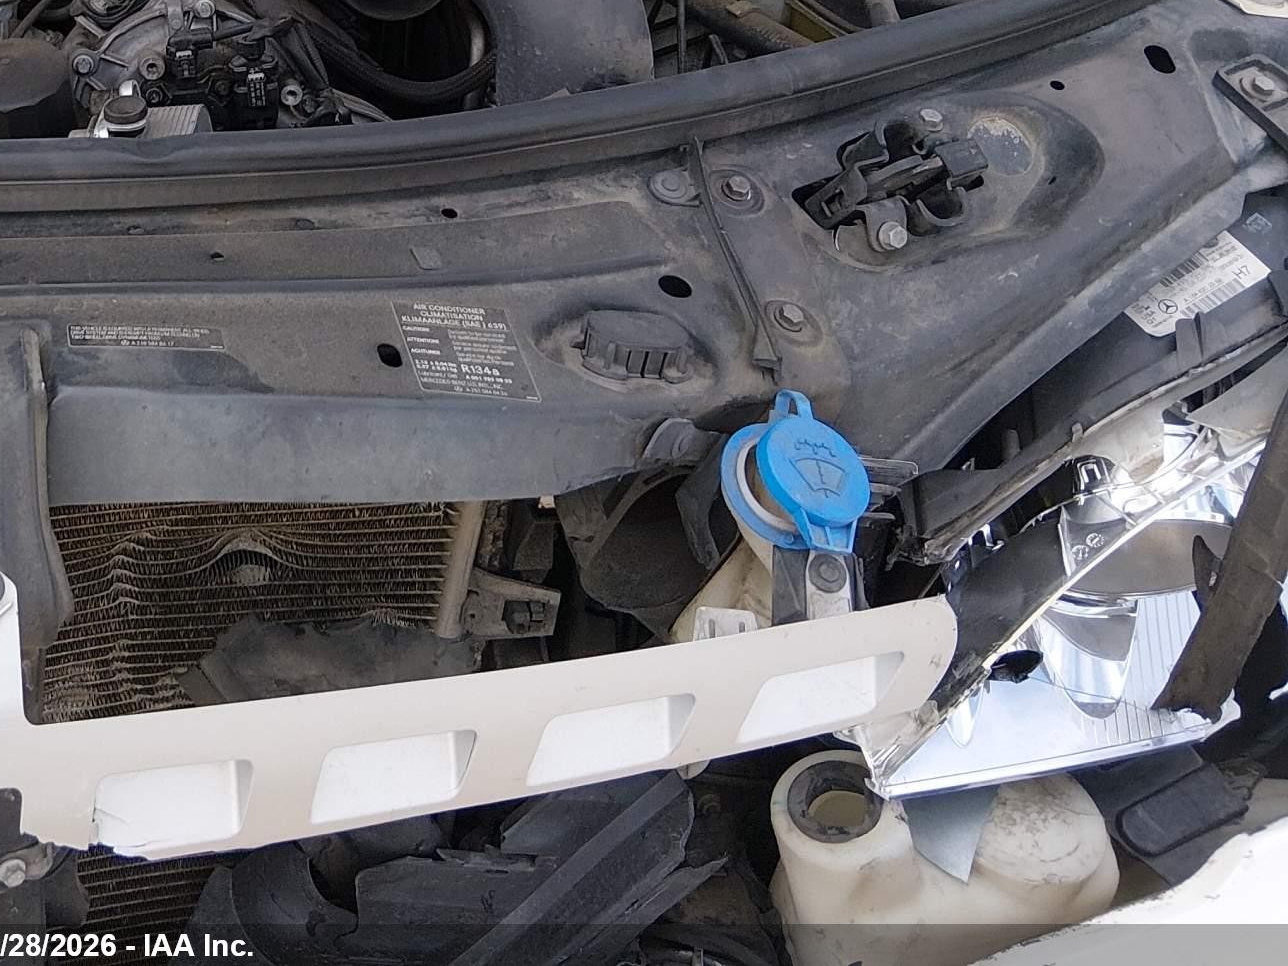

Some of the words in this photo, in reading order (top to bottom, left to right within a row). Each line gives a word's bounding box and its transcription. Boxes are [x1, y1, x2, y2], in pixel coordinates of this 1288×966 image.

[1232, 265, 1251, 280] H7
[413, 302, 428, 311] AIR
[428, 304, 486, 315] CONDITIONER
[420, 310, 483, 321] CLIMATISATION
[401, 315, 461, 326] KLIMAANLAGE
[488, 322, 507, 330] 639)
[461, 364, 500, 376] R134a
